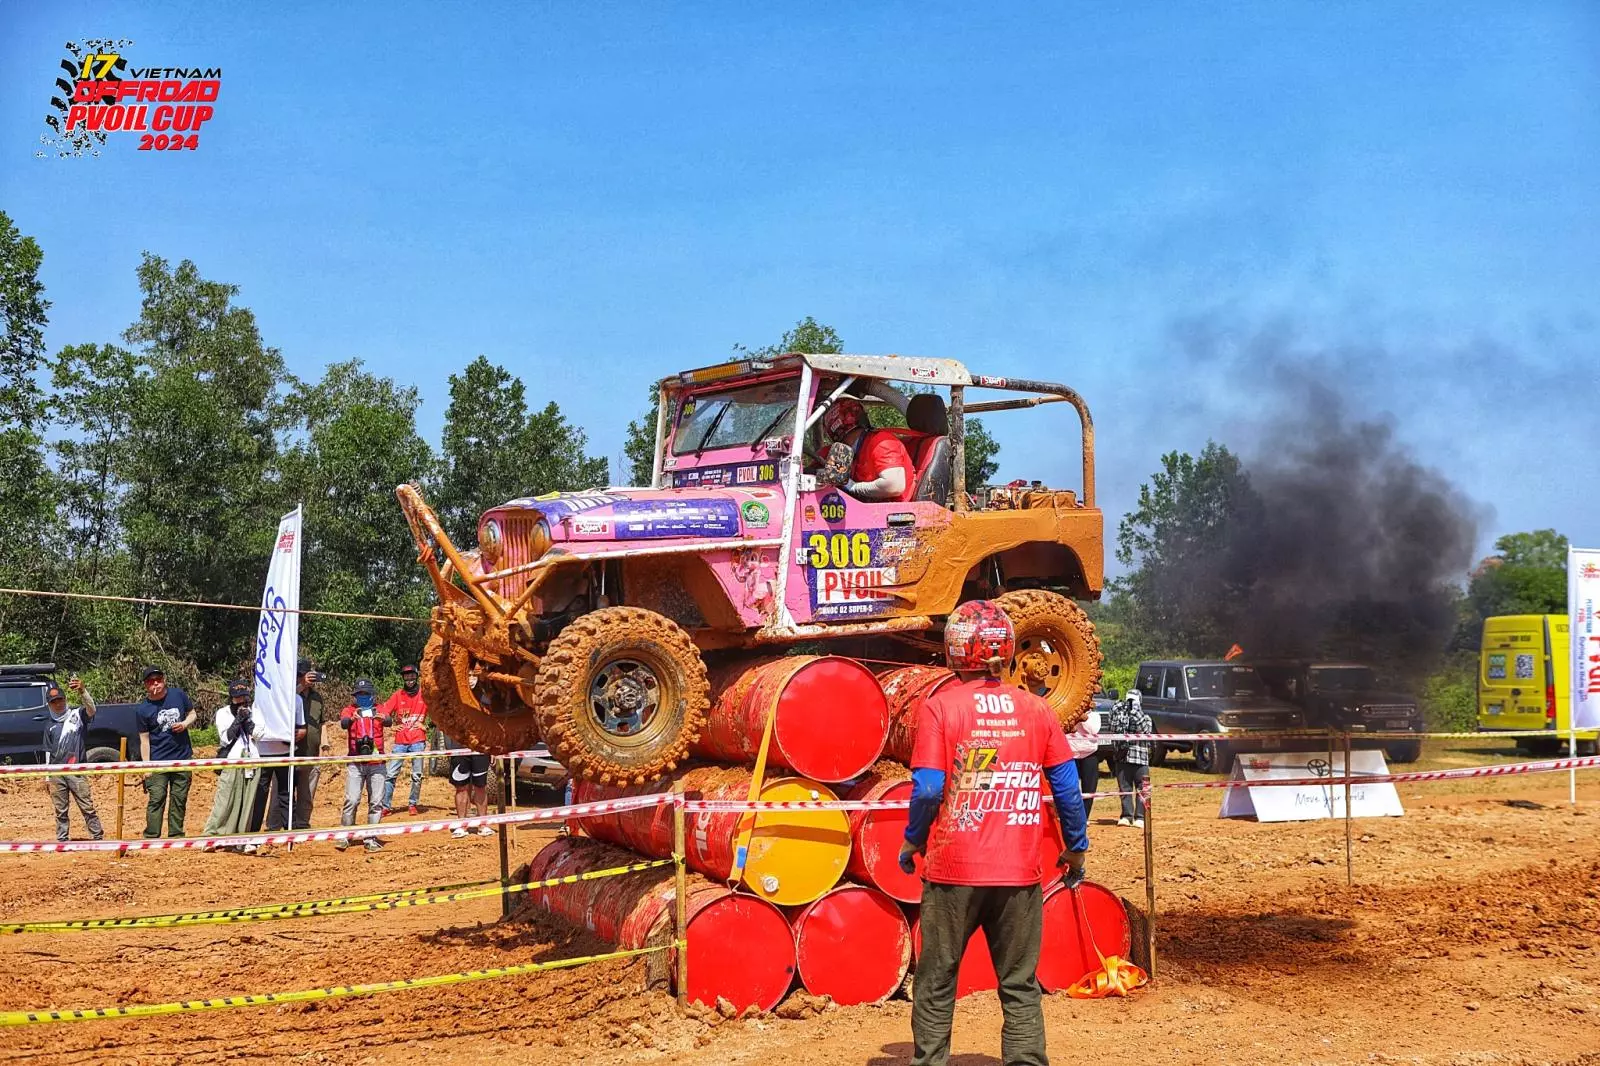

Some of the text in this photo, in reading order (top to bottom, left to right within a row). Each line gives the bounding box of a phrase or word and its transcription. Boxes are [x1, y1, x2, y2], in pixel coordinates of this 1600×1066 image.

[759, 464, 774, 481] 306
[821, 504, 845, 519] 306
[809, 532, 871, 569] 306
[825, 570, 888, 601] PVOIL
[255, 586, 286, 690] Ford
[973, 693, 1015, 714] 306
[966, 748, 998, 771] 17
[953, 789, 1015, 812] PVOIL
[1005, 812, 1040, 826] 2024
